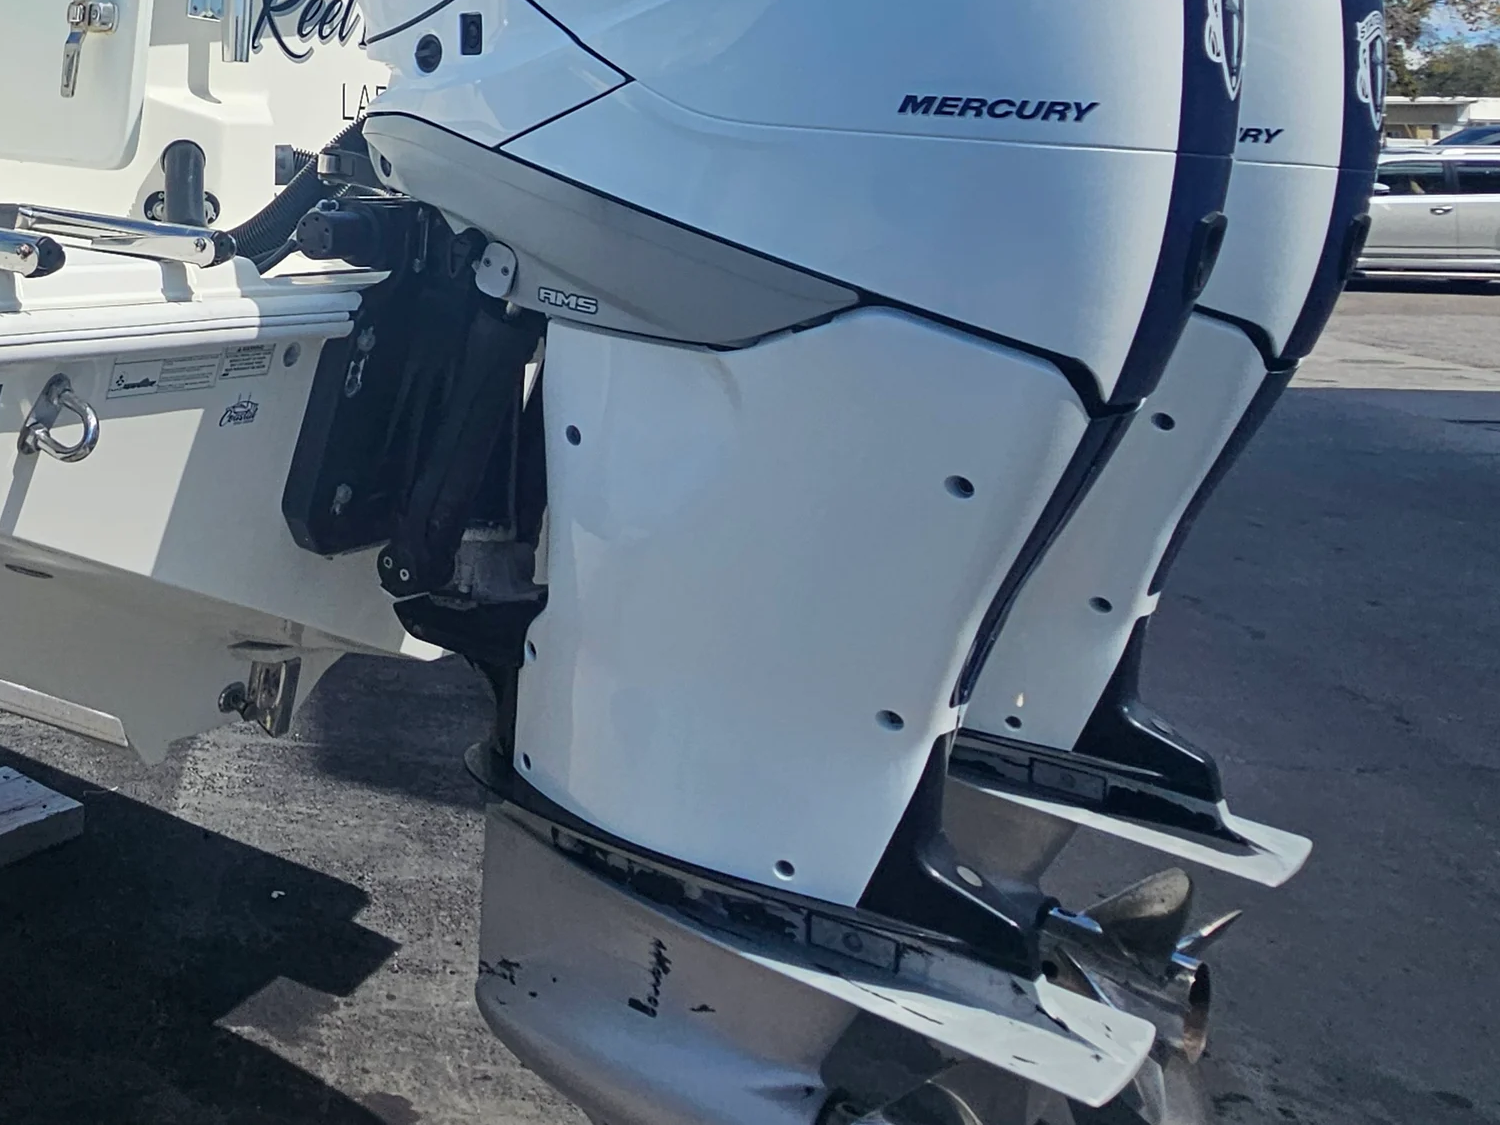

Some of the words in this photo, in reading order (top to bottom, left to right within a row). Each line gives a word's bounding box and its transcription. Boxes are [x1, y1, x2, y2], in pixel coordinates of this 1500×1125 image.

[897, 94, 1100, 123] MERCURY
[1239, 127, 1285, 144] RY
[538, 286, 598, 315] AMS
